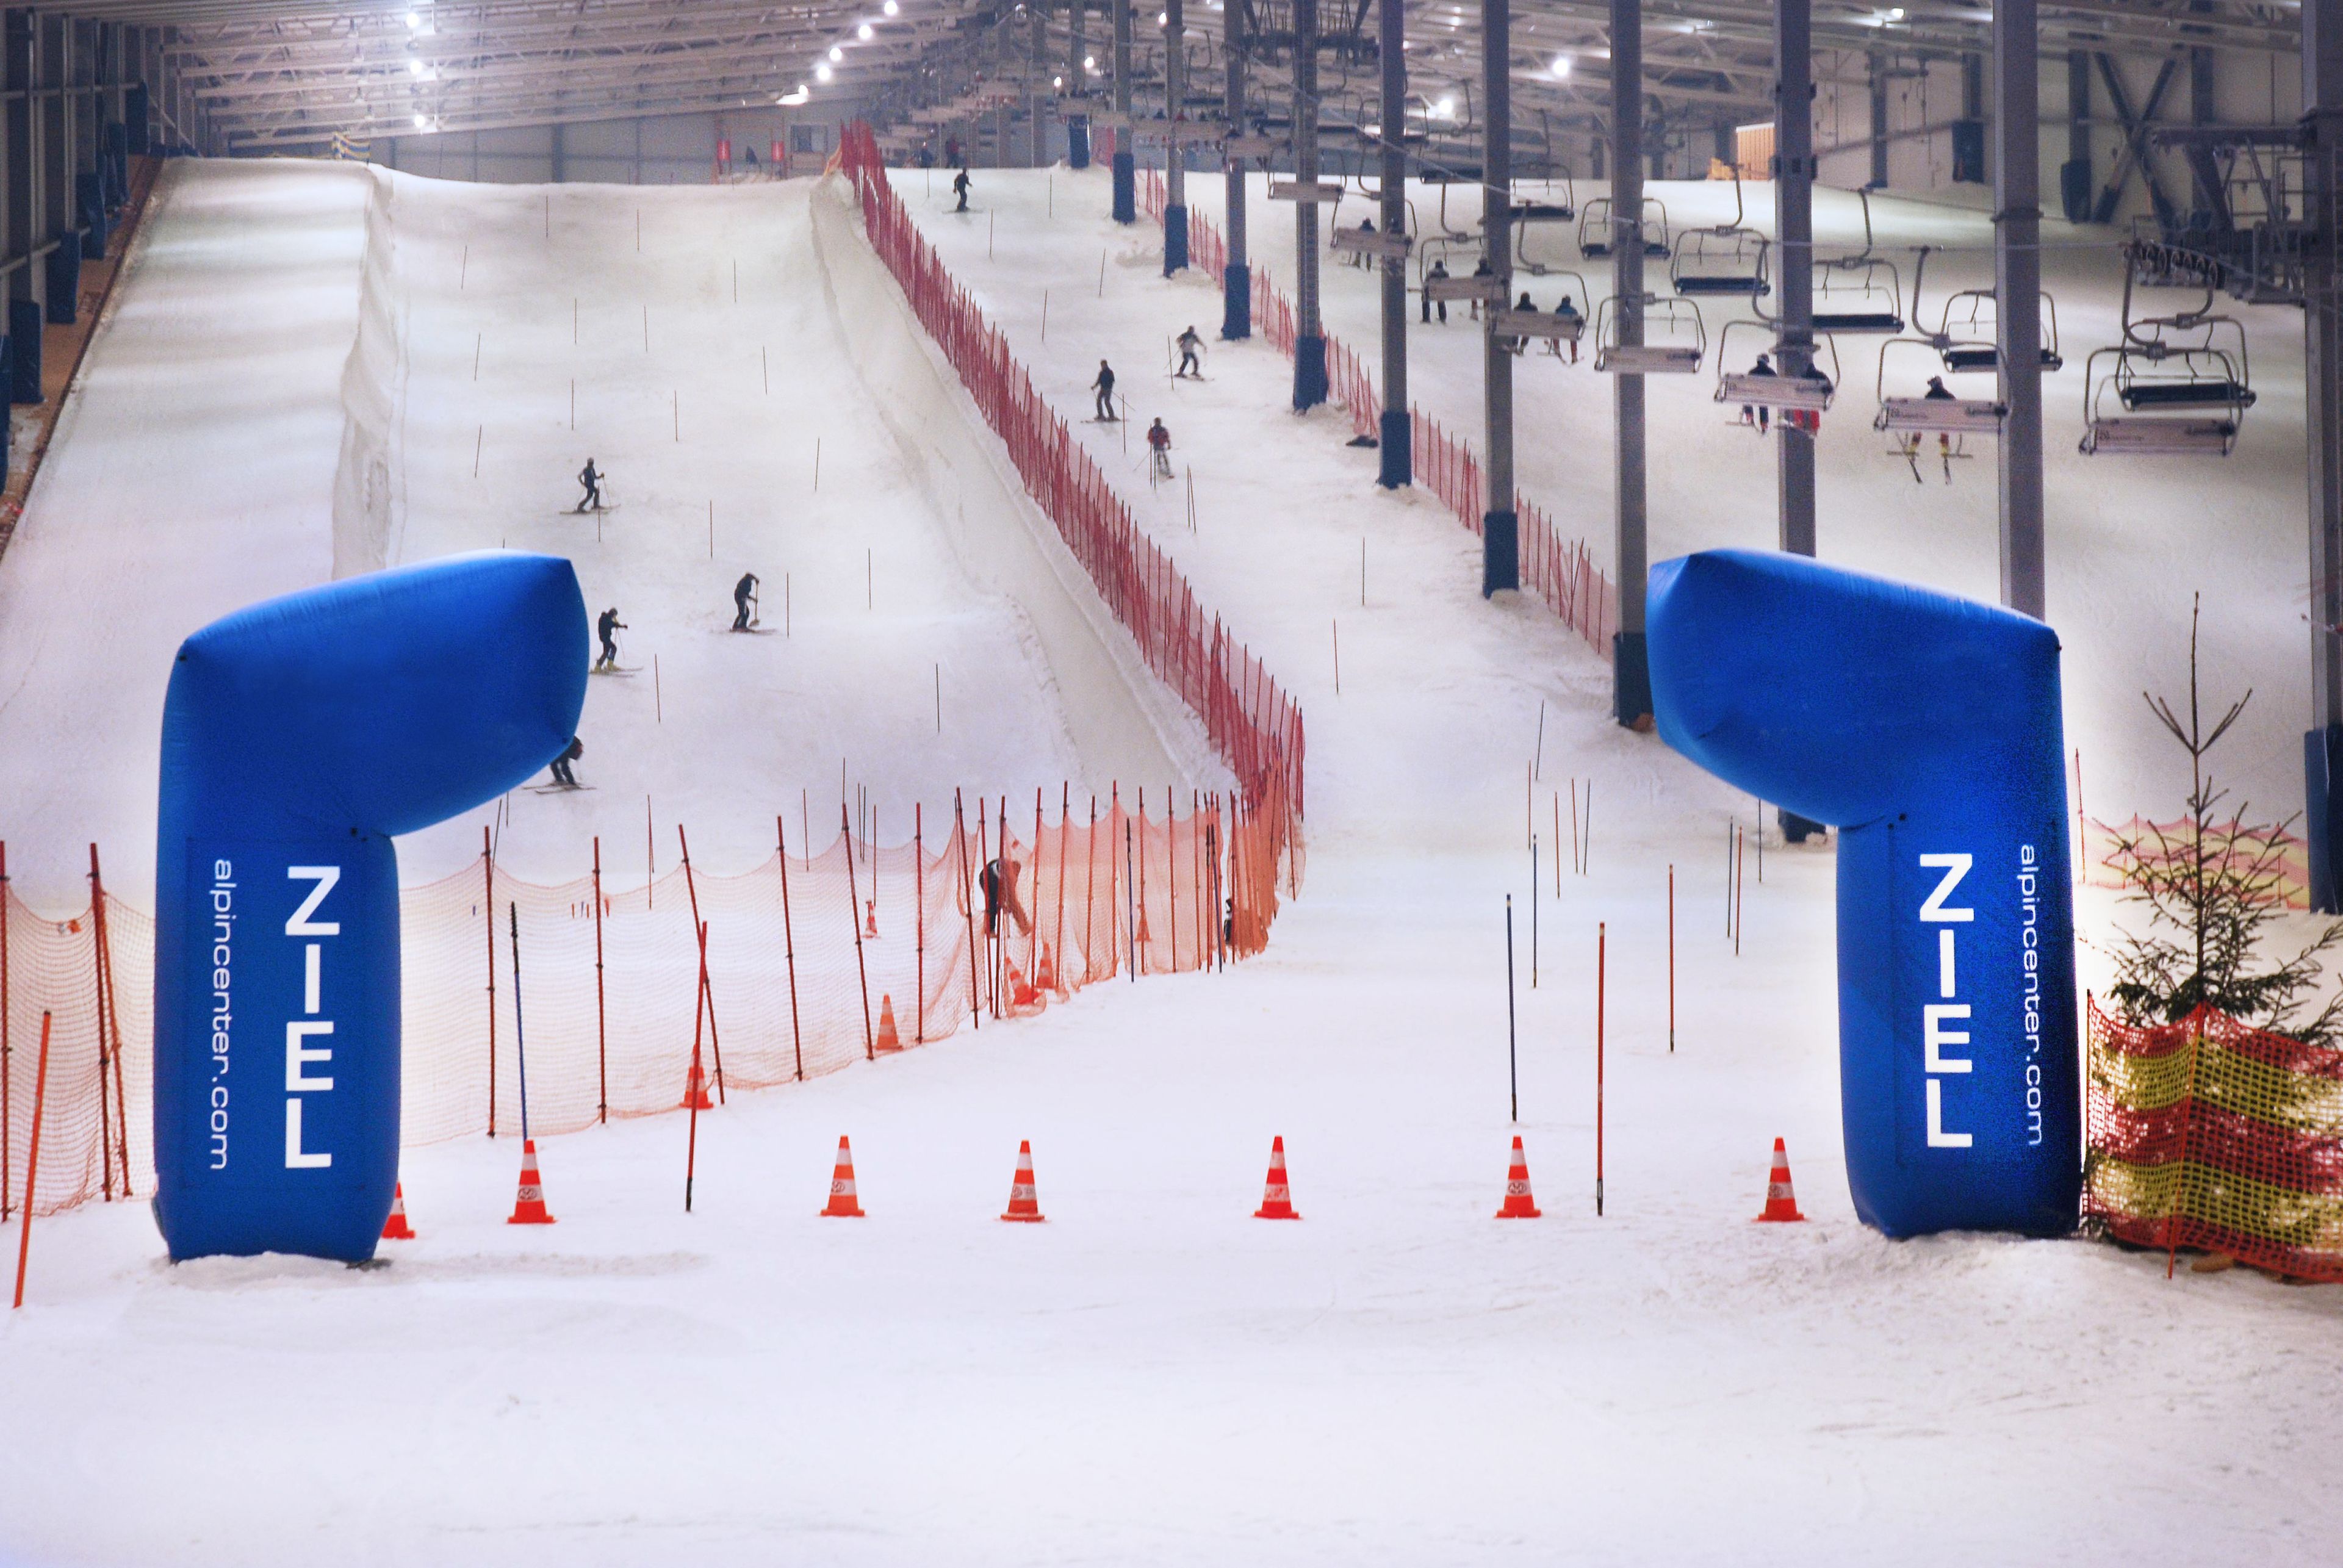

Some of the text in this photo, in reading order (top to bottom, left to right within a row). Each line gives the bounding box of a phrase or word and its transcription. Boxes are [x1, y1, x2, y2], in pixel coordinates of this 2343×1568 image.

[211, 860, 236, 1169] alpincenter.com
[286, 866, 340, 1168] ZIEL
[1920, 854, 1974, 1148] ZIEL
[2017, 845, 2042, 1145] alpincenter.com
